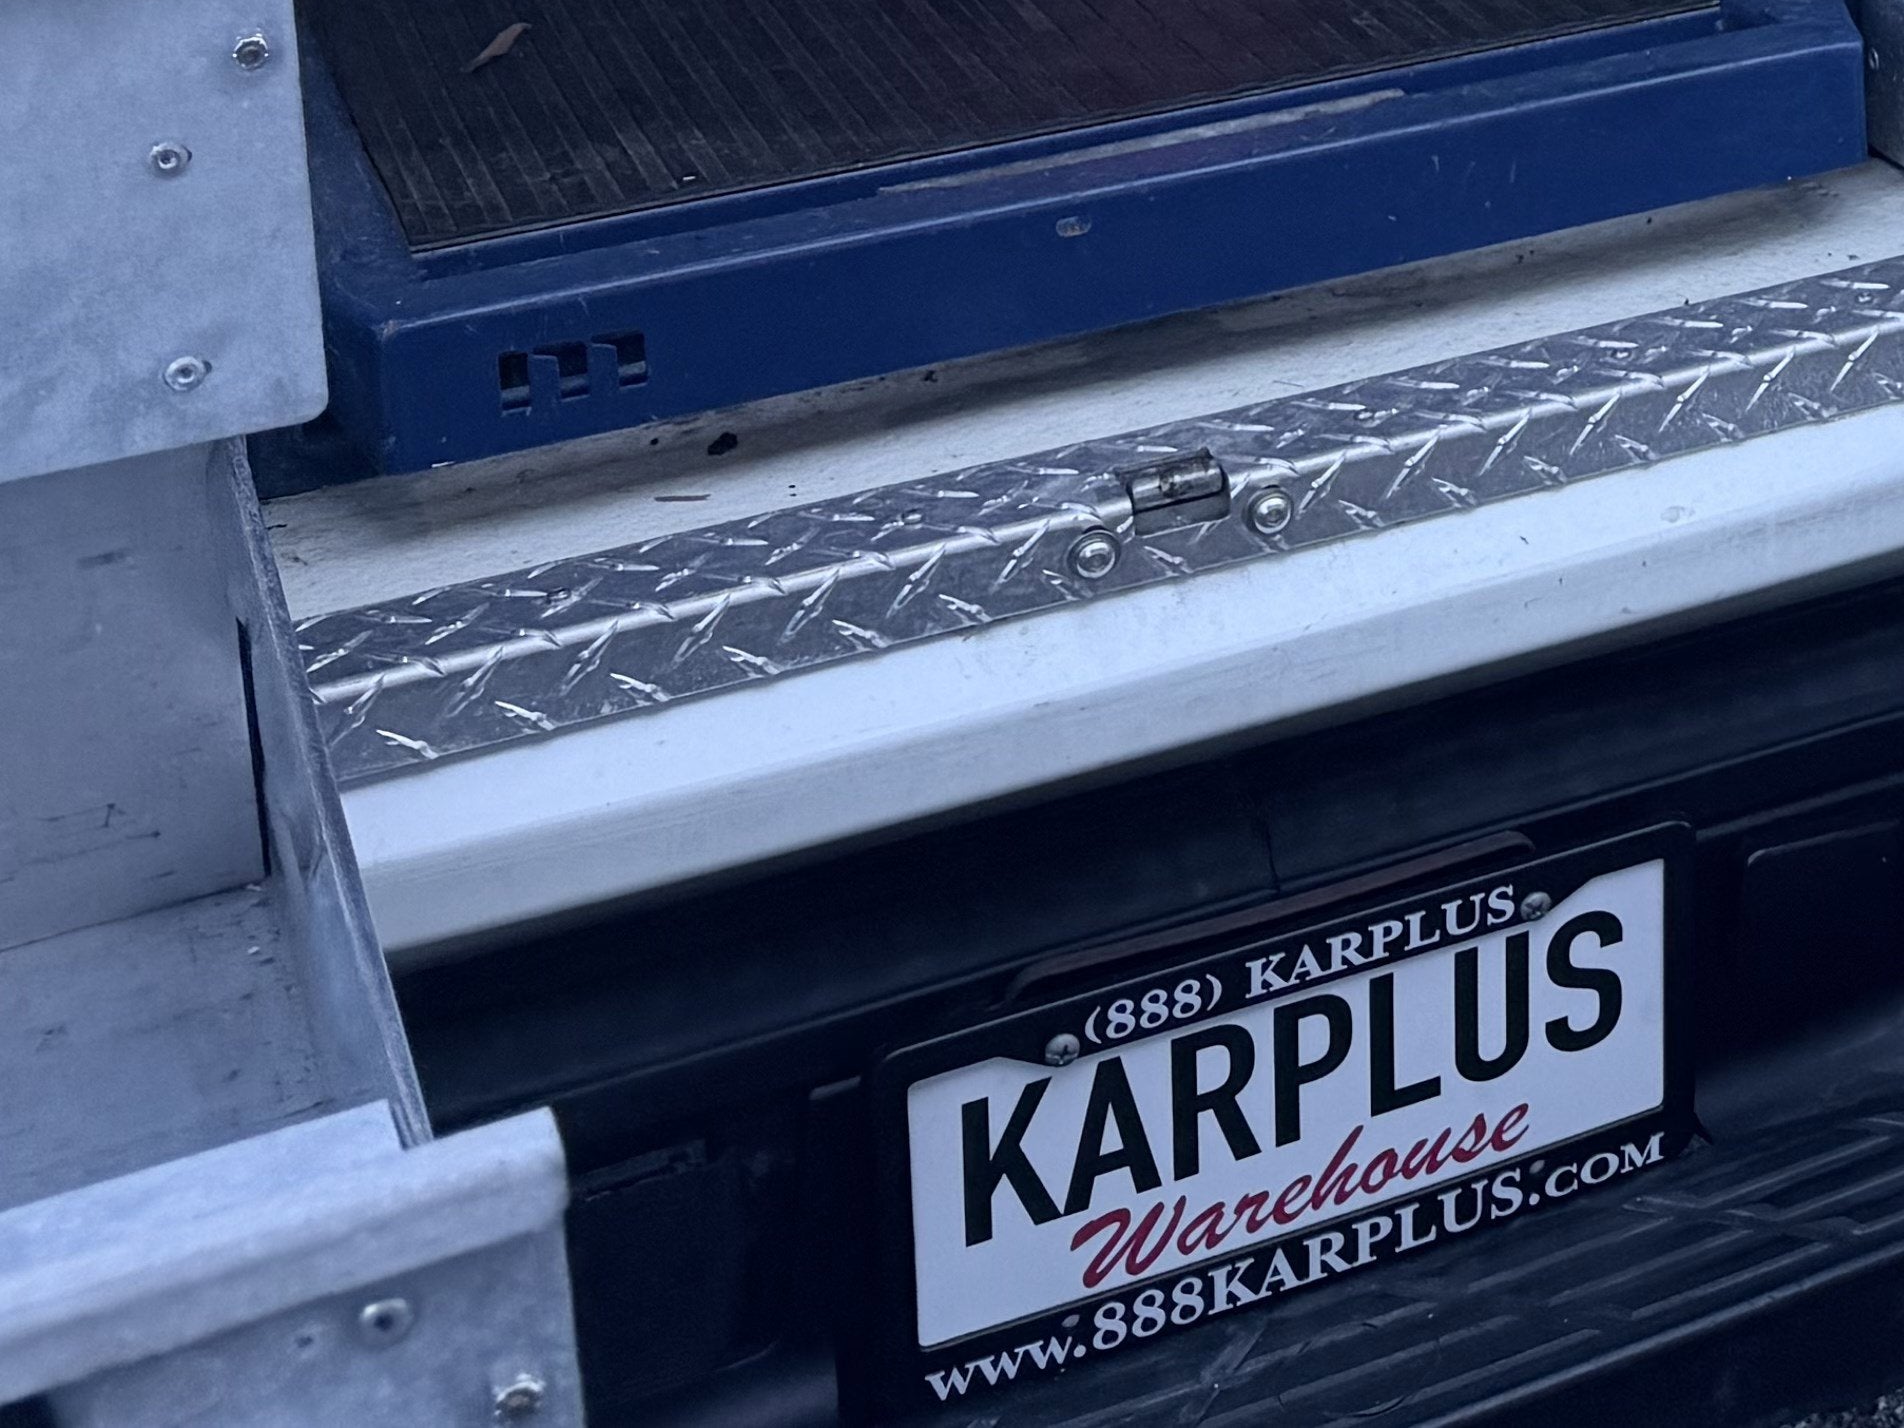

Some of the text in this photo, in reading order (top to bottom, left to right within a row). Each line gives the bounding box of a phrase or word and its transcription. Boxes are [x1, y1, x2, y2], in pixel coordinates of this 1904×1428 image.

[1083, 884, 1516, 1045] (888) KARPLUS
[961, 910, 1625, 1248] KARPLUS
[1069, 1101, 1531, 1288] Warehouse
